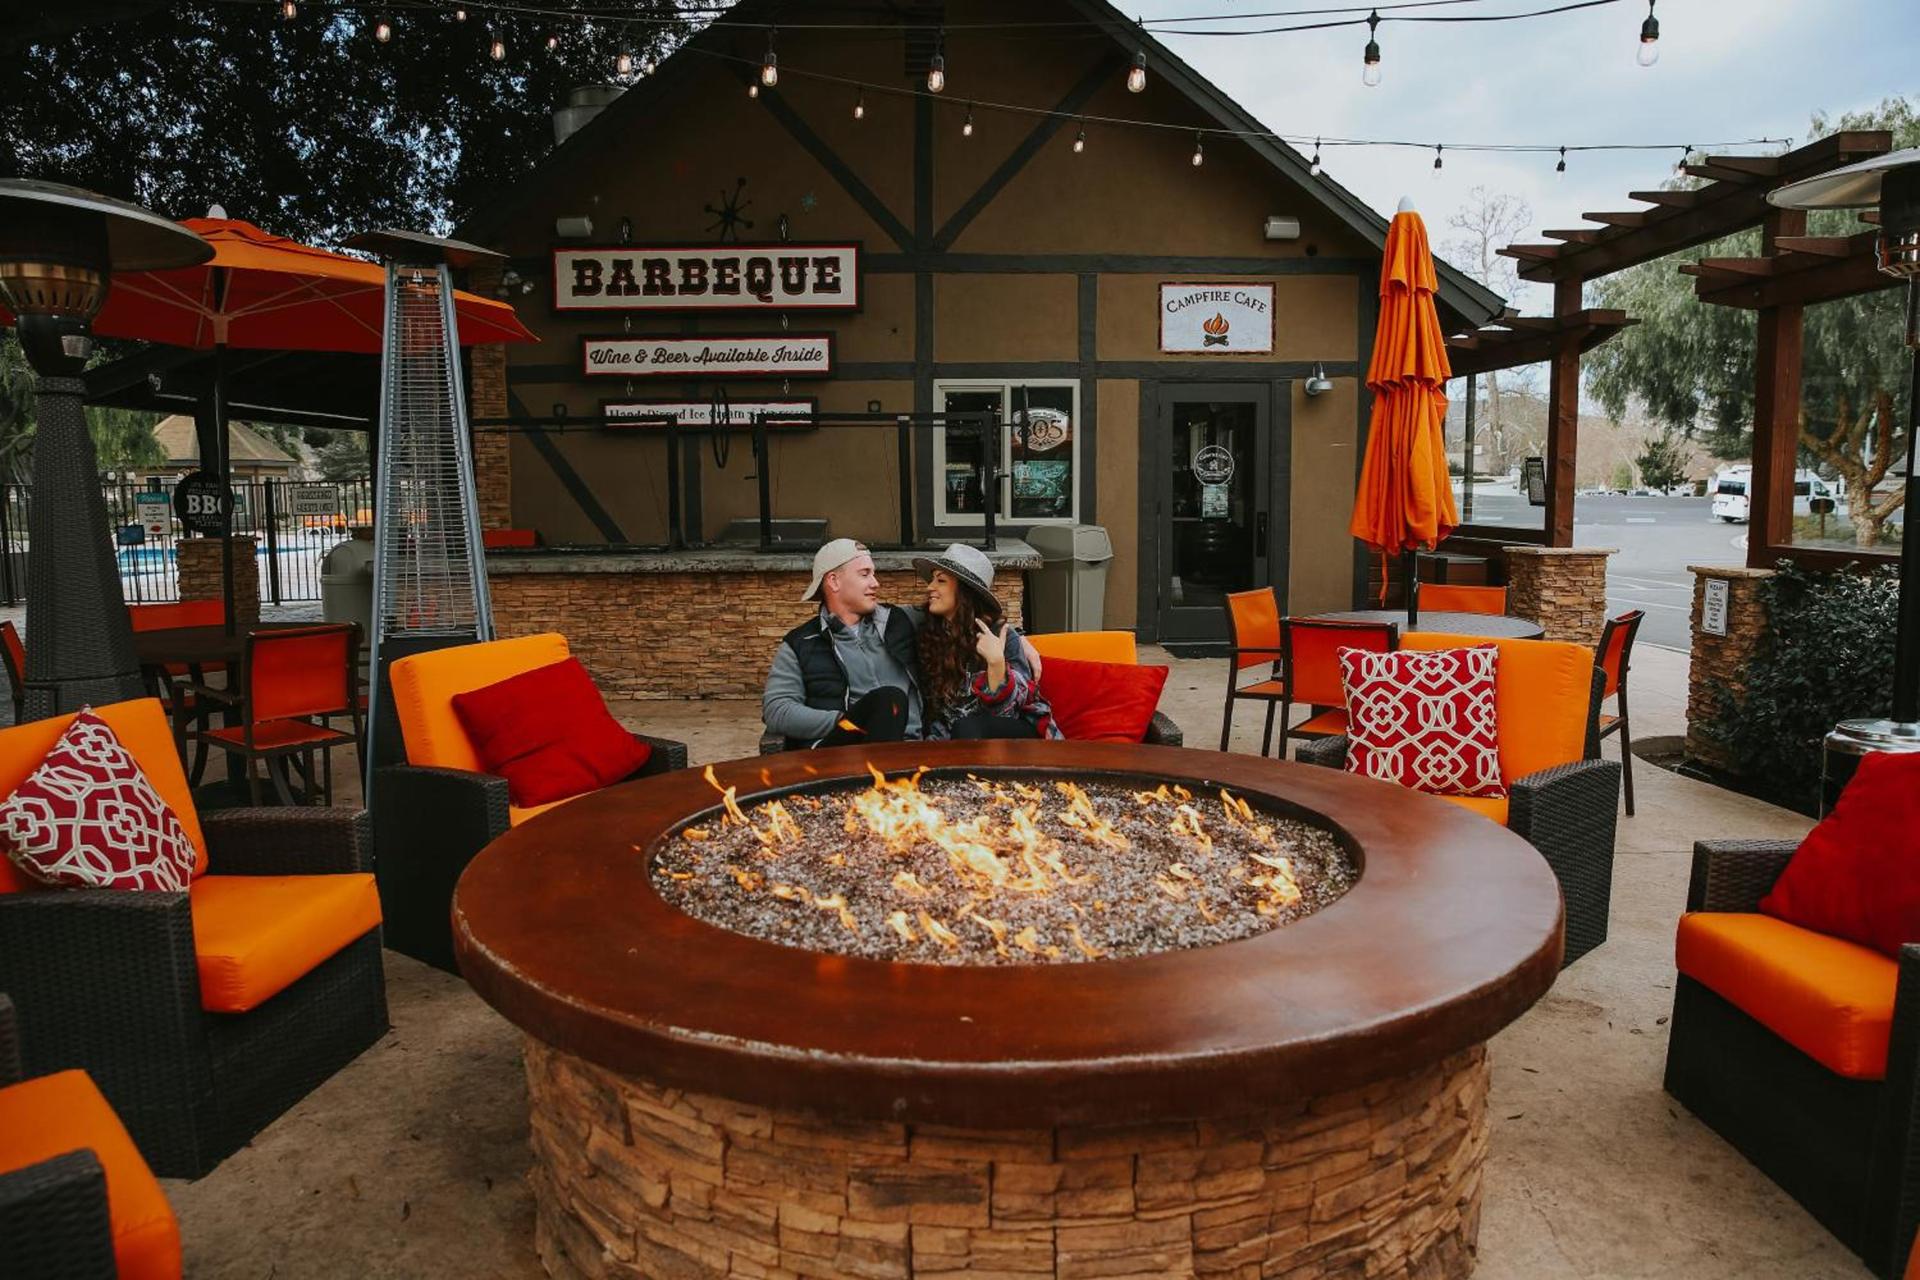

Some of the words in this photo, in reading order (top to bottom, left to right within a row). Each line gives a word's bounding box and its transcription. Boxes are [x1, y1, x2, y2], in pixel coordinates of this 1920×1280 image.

[571, 256, 842, 303] BARBEQUE
[1166, 291, 1231, 313] CAMPFIRE
[1234, 291, 1267, 313] CAFE
[589, 348, 632, 364] Wine
[634, 348, 648, 363] &
[650, 346, 692, 364] Beer
[693, 346, 769, 365] Available
[771, 345, 823, 363] Inside
